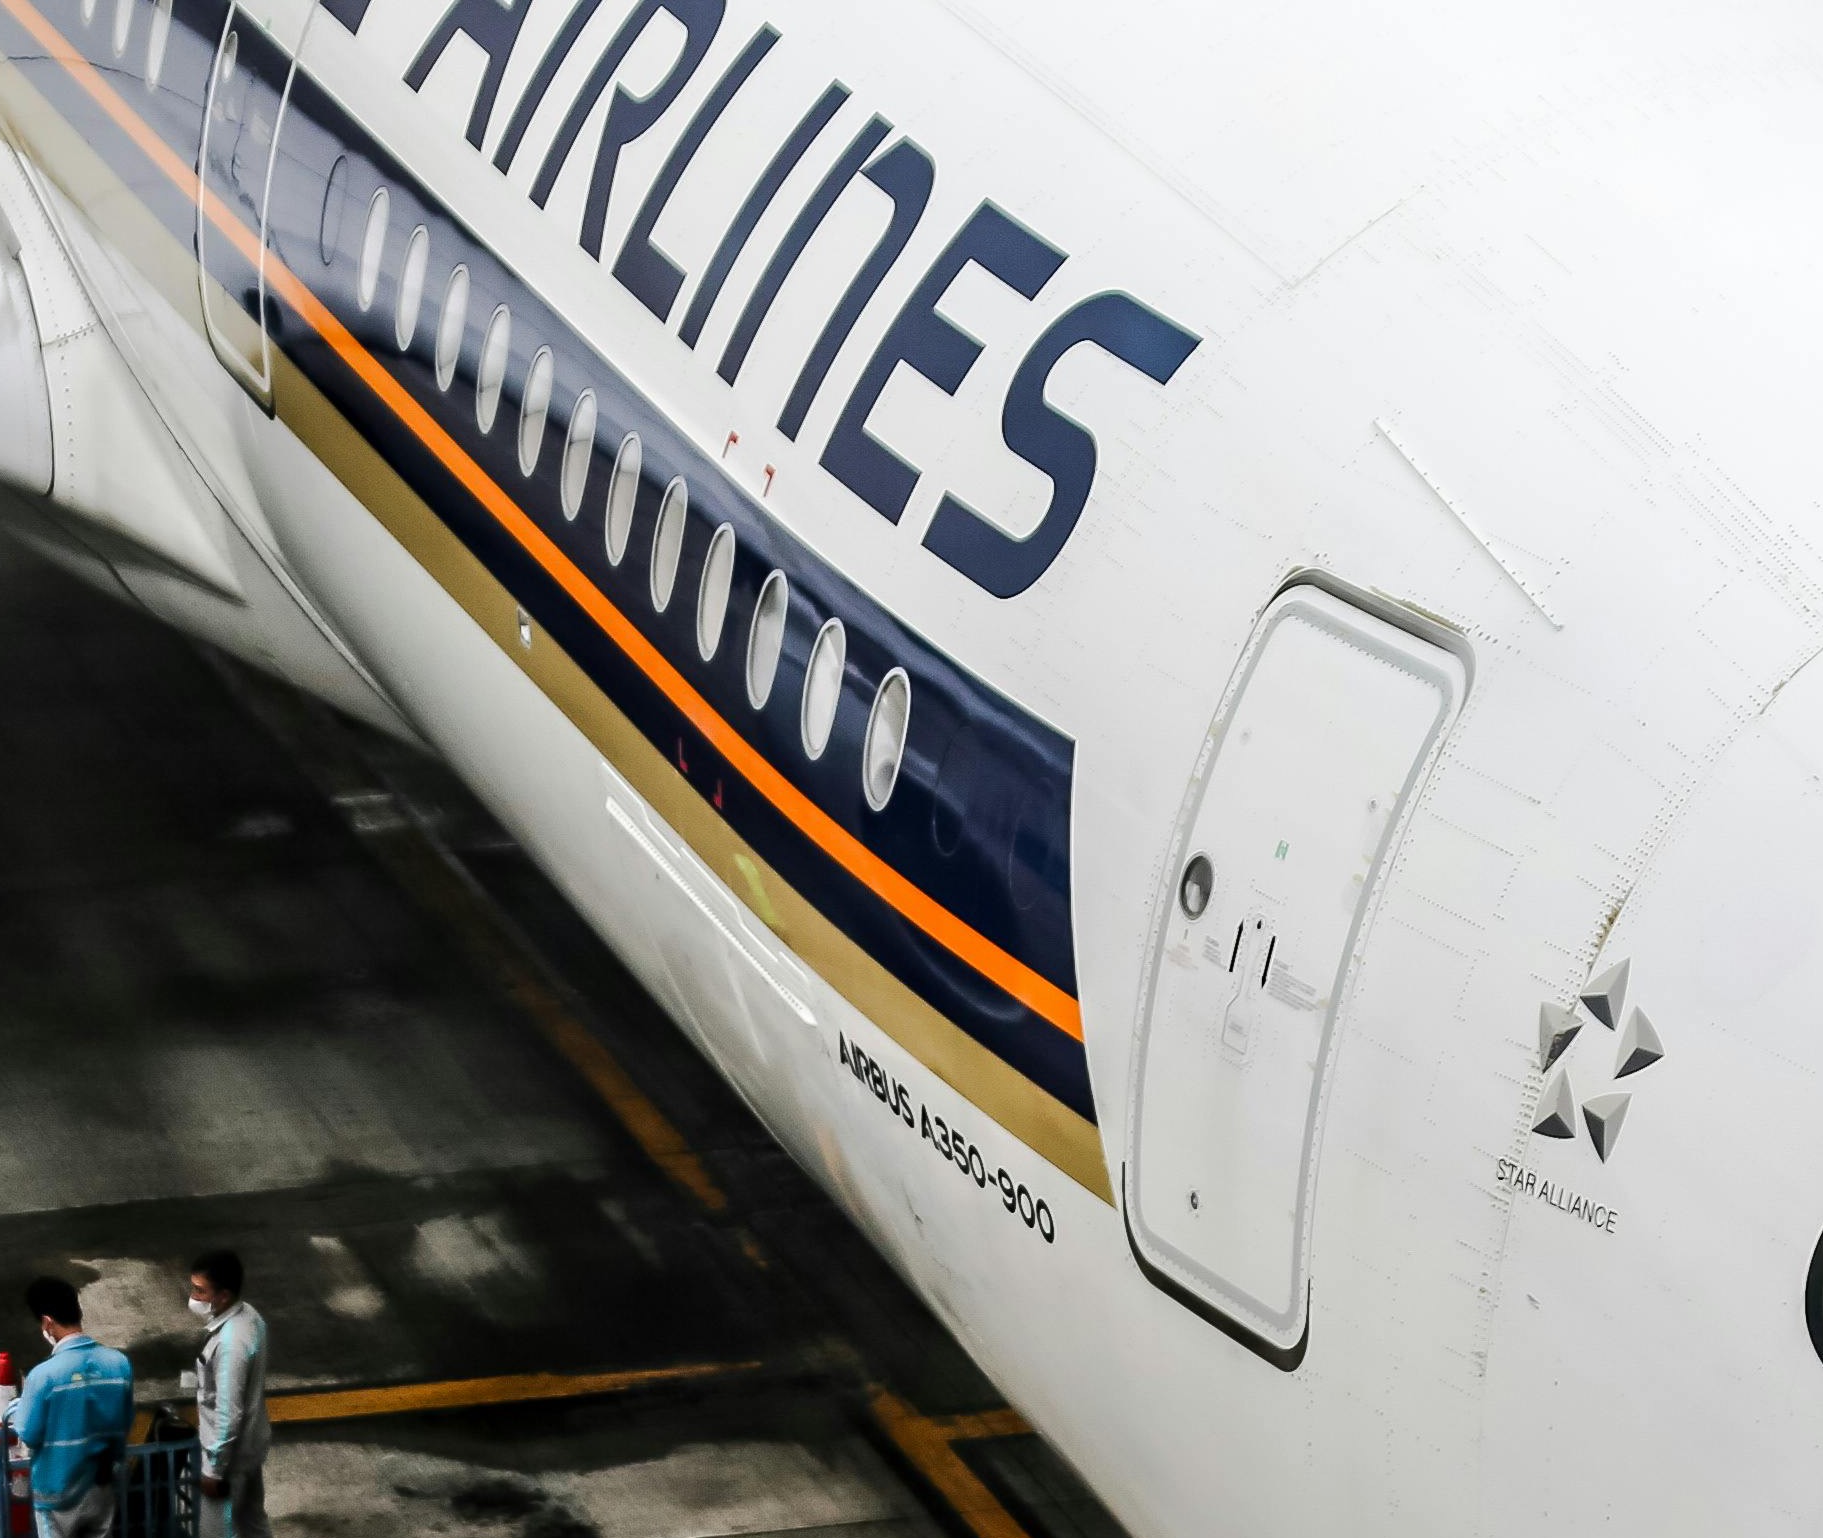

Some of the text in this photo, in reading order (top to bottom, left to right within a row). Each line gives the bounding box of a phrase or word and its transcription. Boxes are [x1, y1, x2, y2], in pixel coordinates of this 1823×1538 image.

[402, 0, 1203, 599] AIRLINES
[839, 1030, 1055, 1244] AIRBUS A350-900
[1497, 1158, 1619, 1234] STAR ALLIANCE
